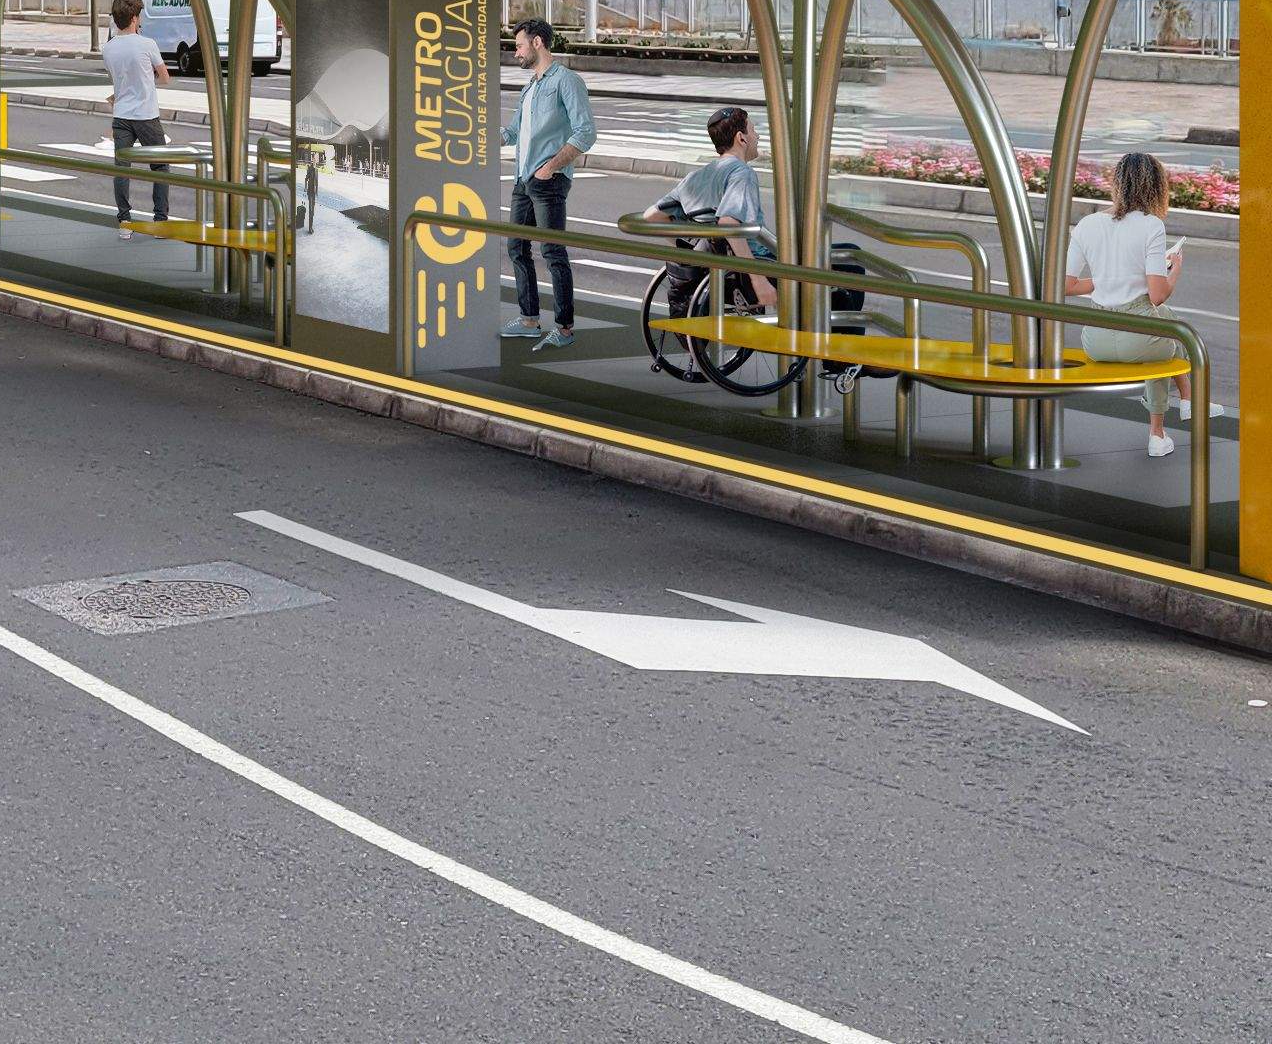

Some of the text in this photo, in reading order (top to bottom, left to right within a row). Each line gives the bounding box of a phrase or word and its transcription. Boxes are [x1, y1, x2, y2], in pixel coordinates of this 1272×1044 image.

[414, 11, 443, 162] METRO
[445, 0, 473, 166] GUAGUA
[478, 72, 487, 101] ALTA
[478, 107, 487, 124] DE
[476, 128, 487, 166] LÍNEA
